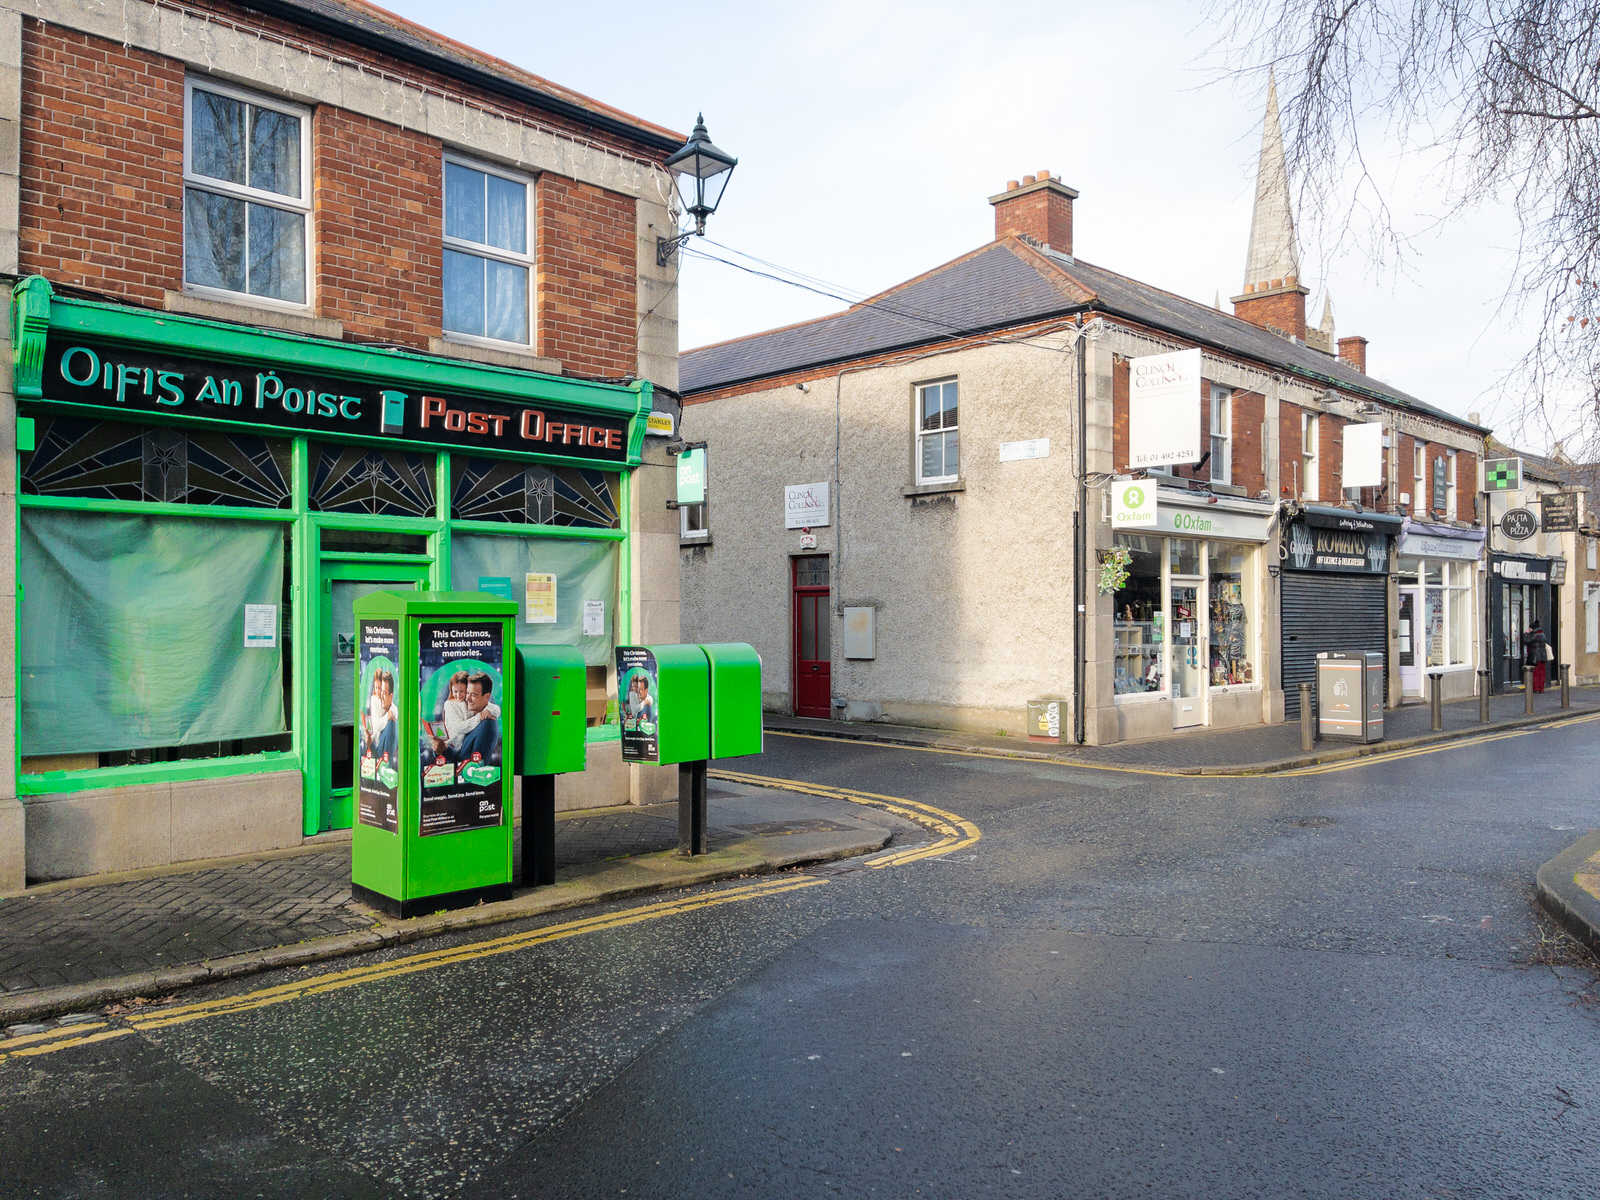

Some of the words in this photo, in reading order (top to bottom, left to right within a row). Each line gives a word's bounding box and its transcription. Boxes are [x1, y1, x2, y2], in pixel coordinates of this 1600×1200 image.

[421, 396, 510, 437] POST
[521, 409, 622, 450] OFFICE
[648, 418, 671, 426] STANLEY
[1161, 452, 1174, 460] 492
[1176, 450, 1194, 458] 4251
[680, 465, 691, 475] an
[680, 472, 700, 487] post
[1117, 512, 1151, 521] Oxfam
[1507, 514, 1528, 522] PASTA
[1183, 514, 1212, 531] Oxfam
[1510, 527, 1529, 535] PIZZA
[1317, 531, 1365, 555] ROWANS
[432, 630, 449, 638] This
[450, 630, 491, 638] Christmas,
[432, 640, 448, 648] let's
[442, 649, 482, 657] memories.
